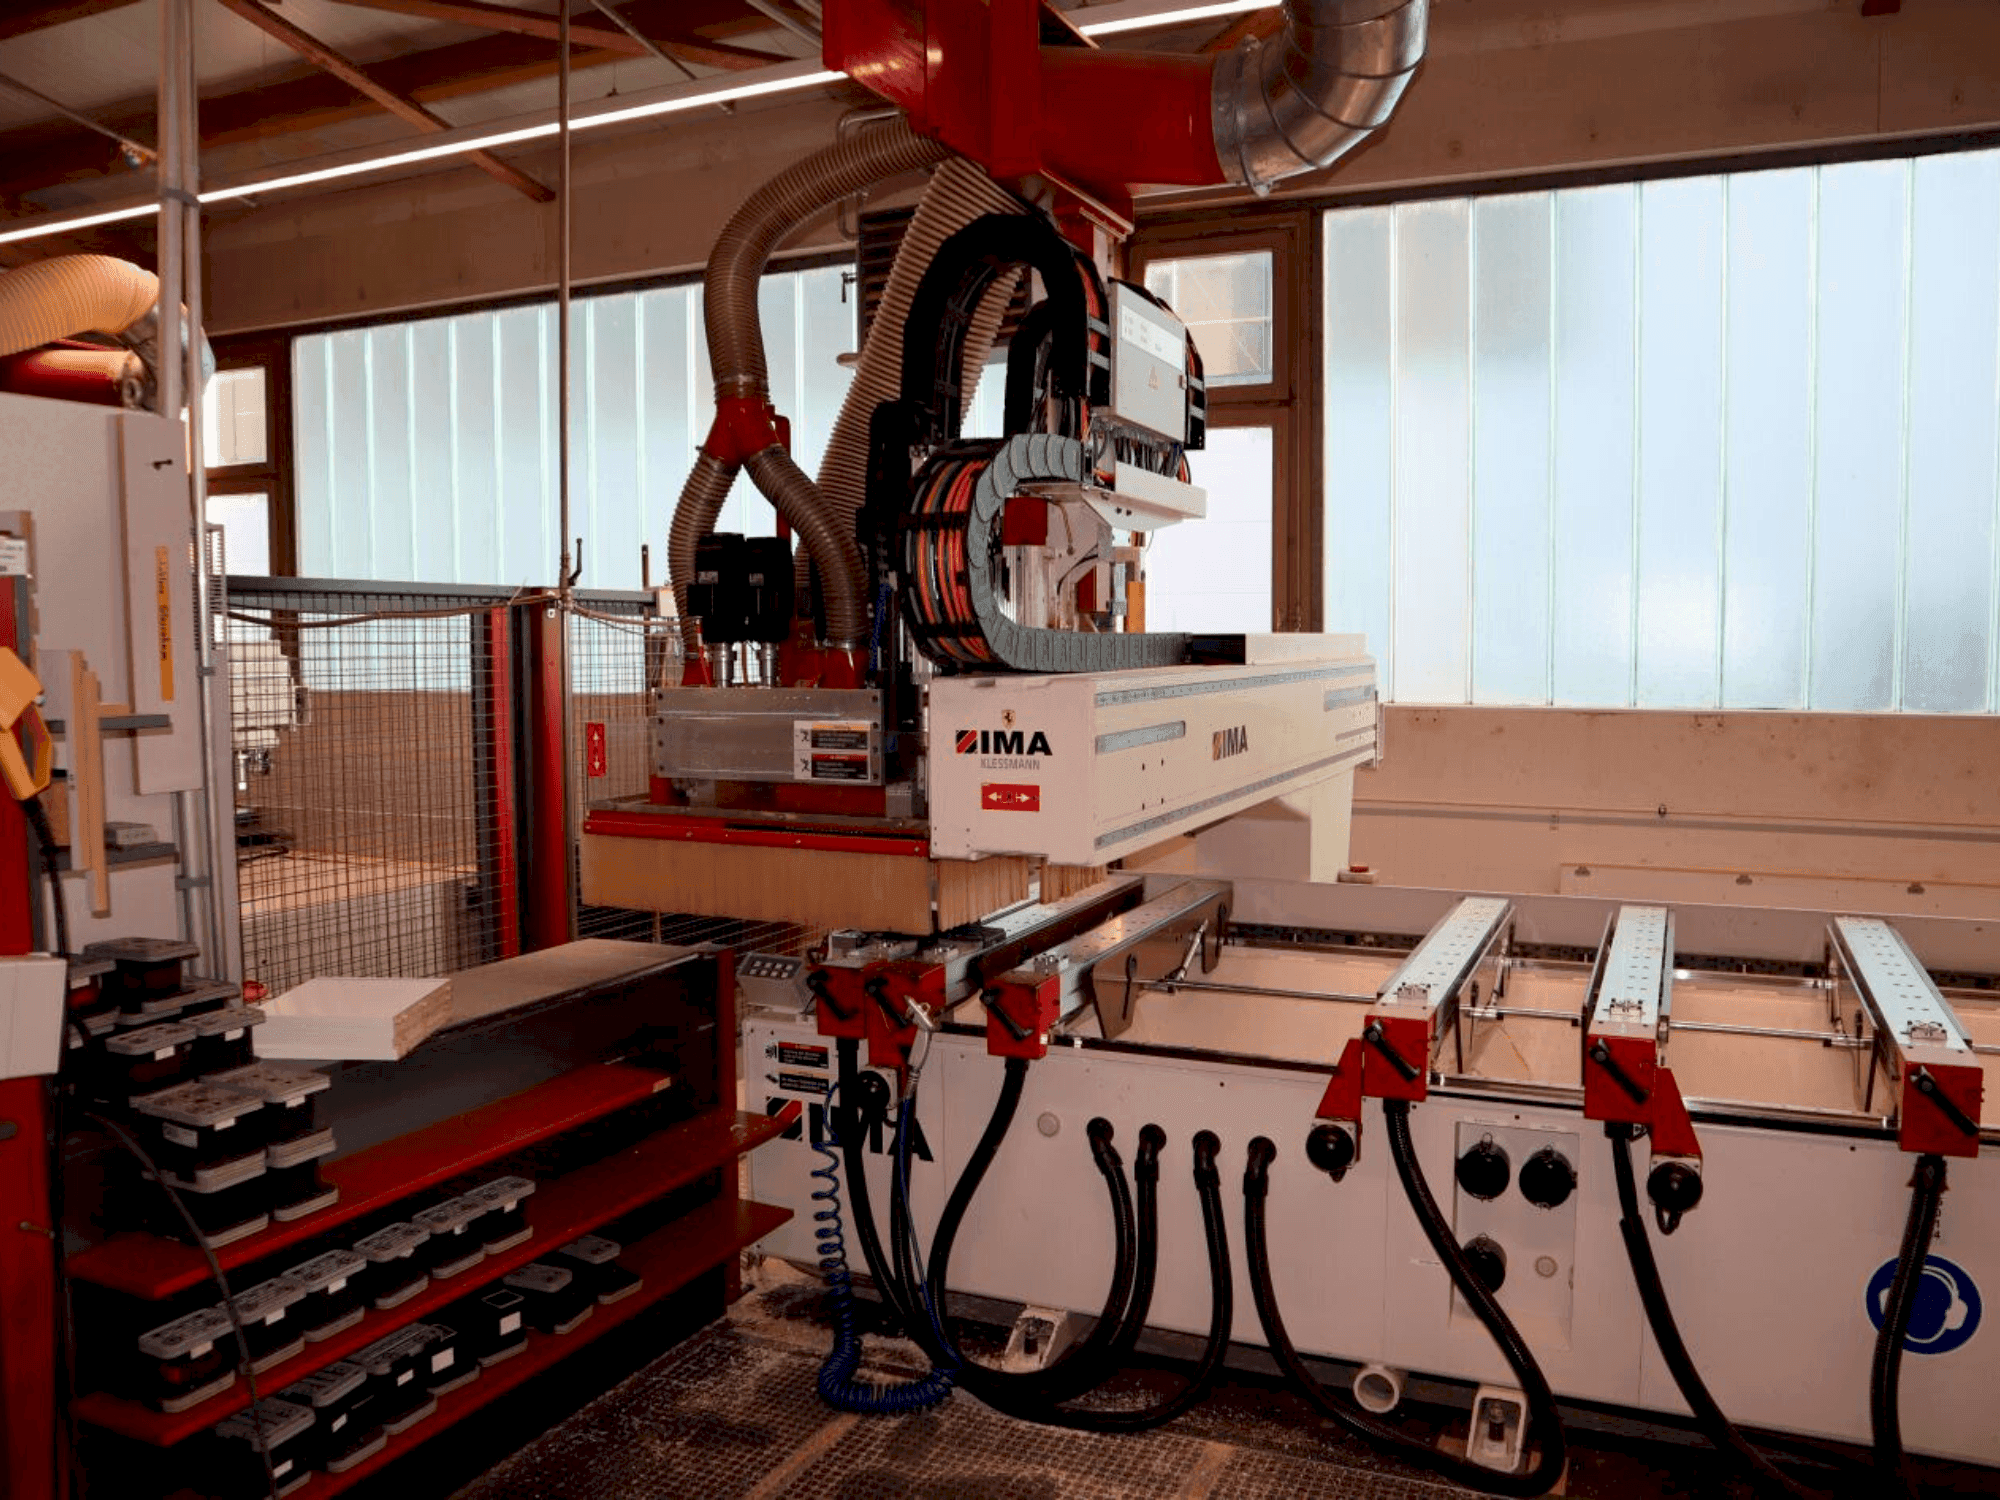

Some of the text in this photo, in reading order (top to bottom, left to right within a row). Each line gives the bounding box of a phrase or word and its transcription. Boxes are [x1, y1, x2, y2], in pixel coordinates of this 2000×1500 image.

[980, 730, 1053, 756] IMA
[1222, 724, 1248, 759] IMA
[980, 758, 1040, 770] KLESSMANN
